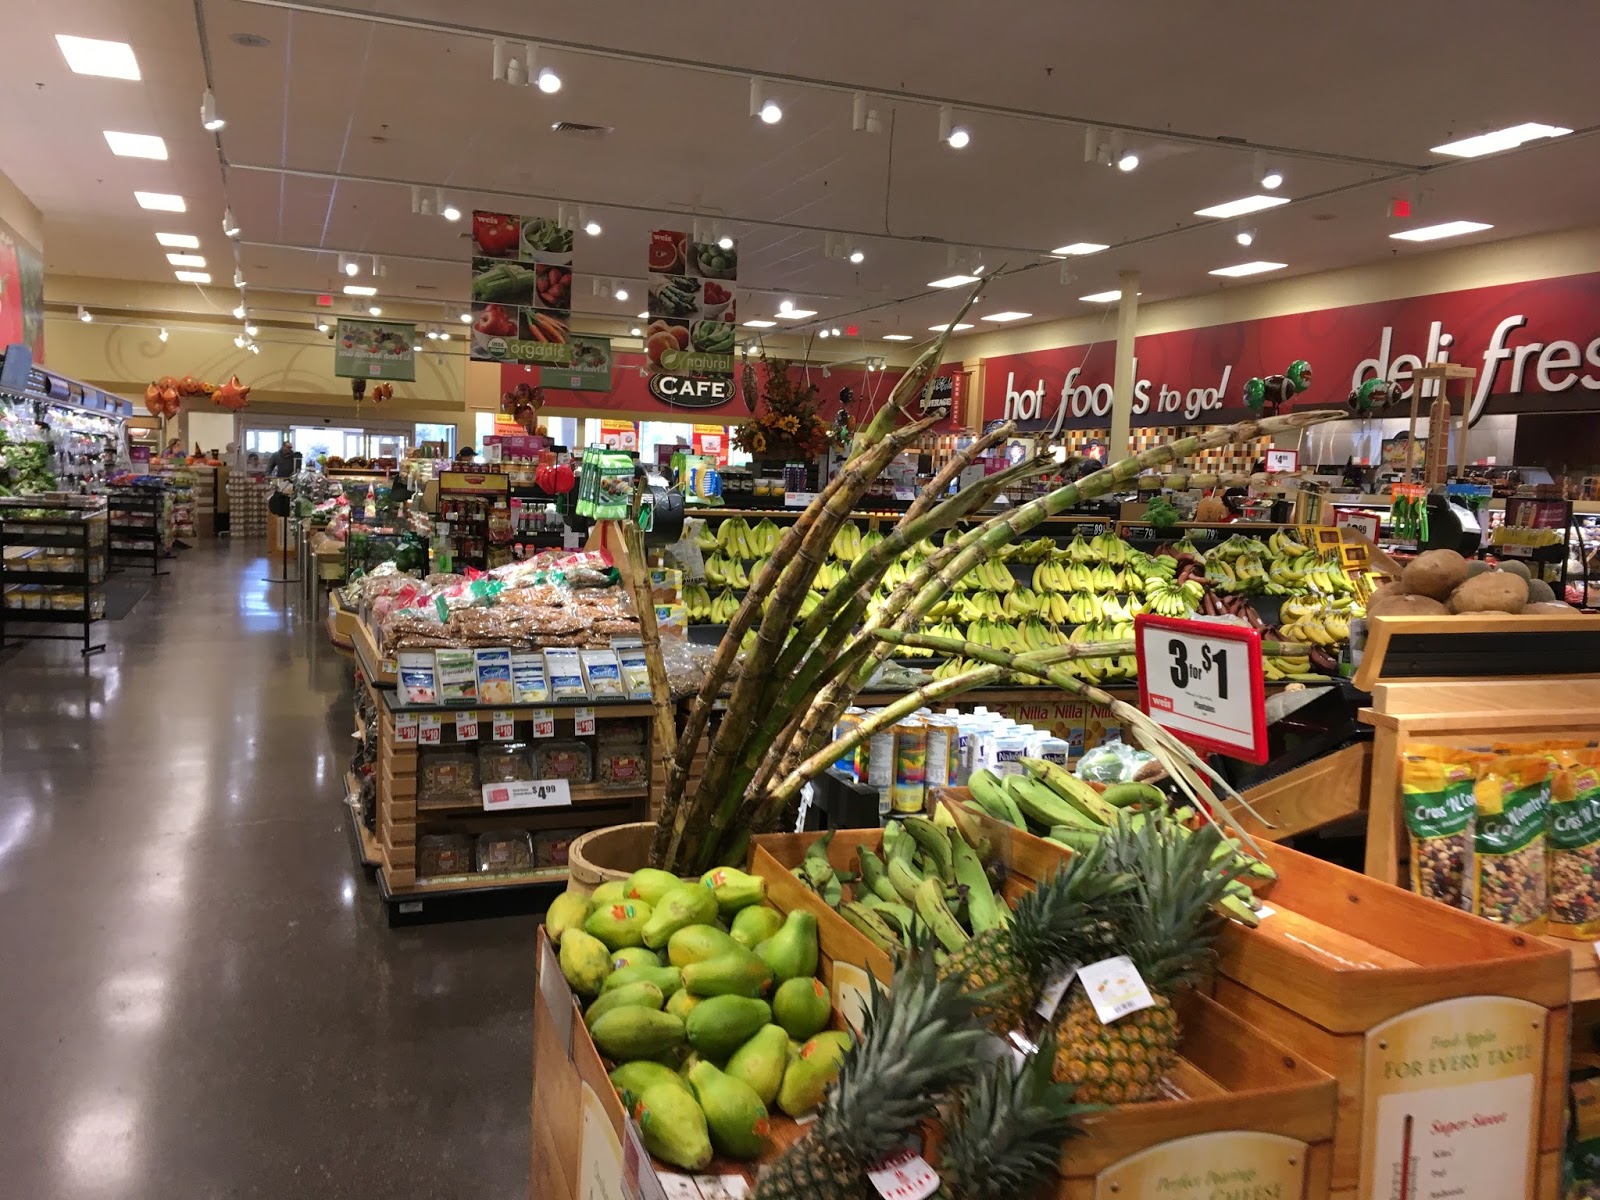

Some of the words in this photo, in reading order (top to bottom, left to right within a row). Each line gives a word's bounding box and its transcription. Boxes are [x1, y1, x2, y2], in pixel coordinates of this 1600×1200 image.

[477, 216, 498, 225] weis
[653, 234, 672, 242] weis
[510, 340, 565, 359] organic
[686, 355, 730, 370] natural
[1352, 320, 1454, 400] deli
[659, 376, 725, 398] CAFE
[1004, 371, 1045, 421] hot
[1157, 383, 1182, 413] to
[1184, 365, 1232, 419] go!
[1168, 638, 1189, 689] 3
[1189, 663, 1202, 680] for
[1202, 642, 1228, 700] $1
[1152, 697, 1171, 709] weis
[1019, 705, 1048, 720] Nilla
[1055, 704, 1083, 719] Nilla
[404, 726, 416, 739] $10
[464, 725, 476, 737] $10
[500, 725, 512, 737] $10
[540, 722, 552, 734] $10
[581, 720, 593, 732] $10
[427, 729, 439, 741] $10
[1384, 1060, 1423, 1079] FOR
[1429, 1053, 1480, 1075] EVERY
